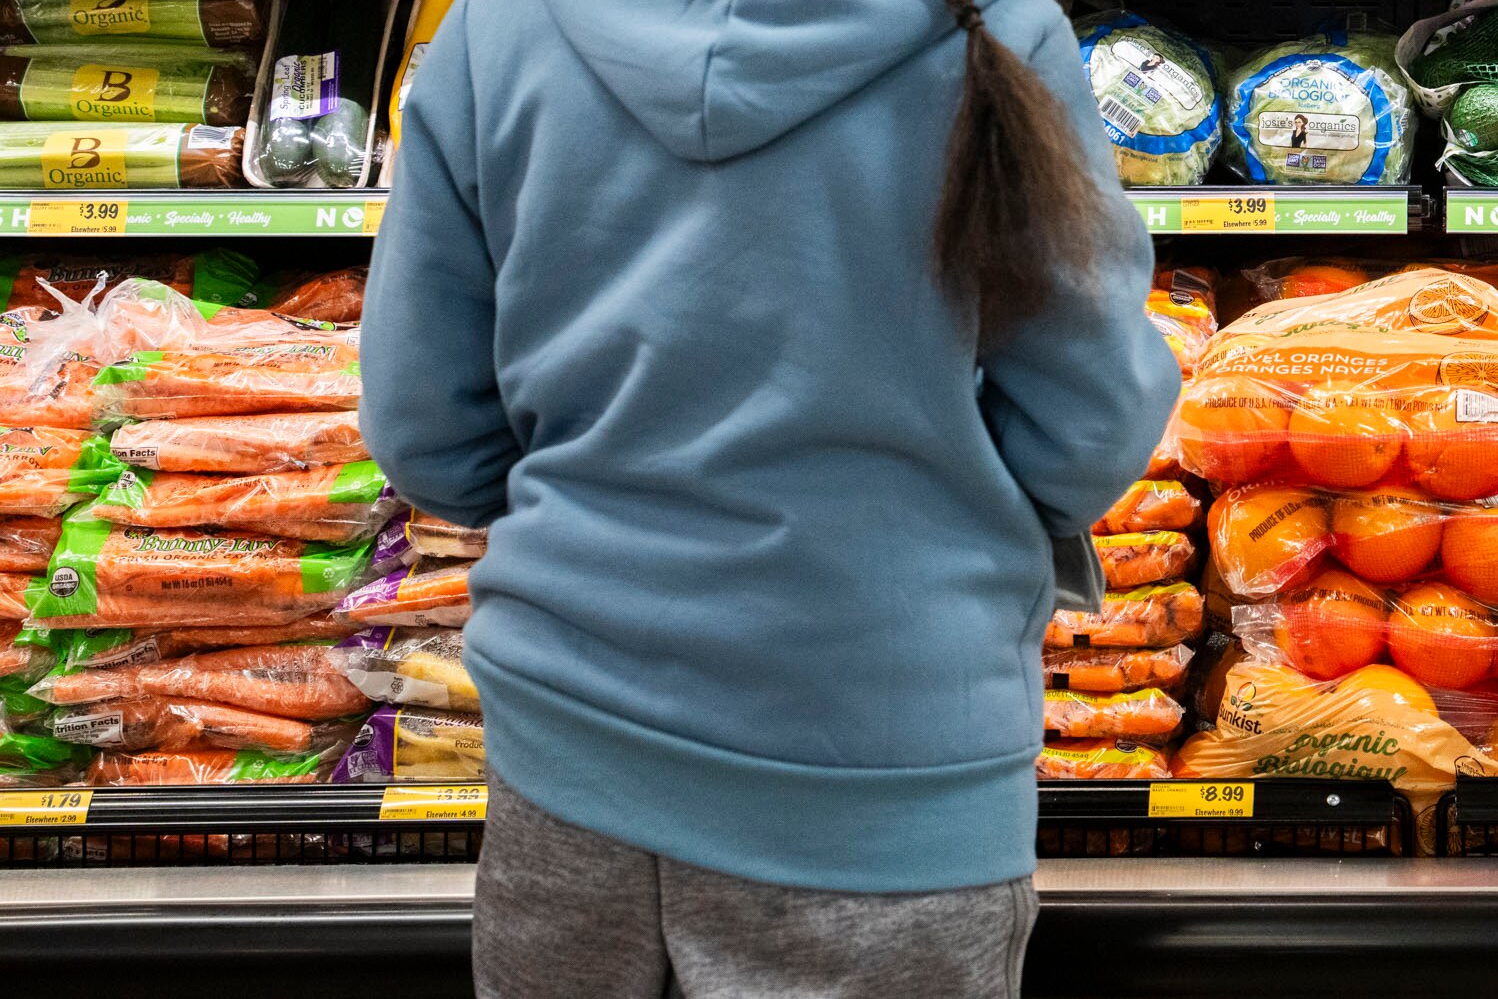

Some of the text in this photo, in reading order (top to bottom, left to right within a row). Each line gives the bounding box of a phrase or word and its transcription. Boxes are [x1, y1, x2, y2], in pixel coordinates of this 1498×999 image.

[73, 7, 148, 29] Organic
[76, 99, 152, 119] Organic
[1261, 116, 1357, 134] josie's organics
[1103, 125, 1125, 145] 4061
[49, 167, 125, 188] Organic
[79, 203, 118, 219] $3.99
[1228, 197, 1266, 214] $3.99
[164, 210, 214, 227] Specialty
[71, 225, 100, 234] Elsewhere
[1296, 352, 1390, 367] ORANGES
[1214, 363, 1389, 375] ORANGES NAVEL
[129, 447, 156, 458] Facts
[54, 573, 73, 582] USDA
[90, 716, 119, 729] Facts
[1285, 729, 1401, 757] organic
[41, 792, 82, 809] $1.79
[1200, 785, 1245, 802] $8.99
[1195, 808, 1227, 817] Elsewhere
